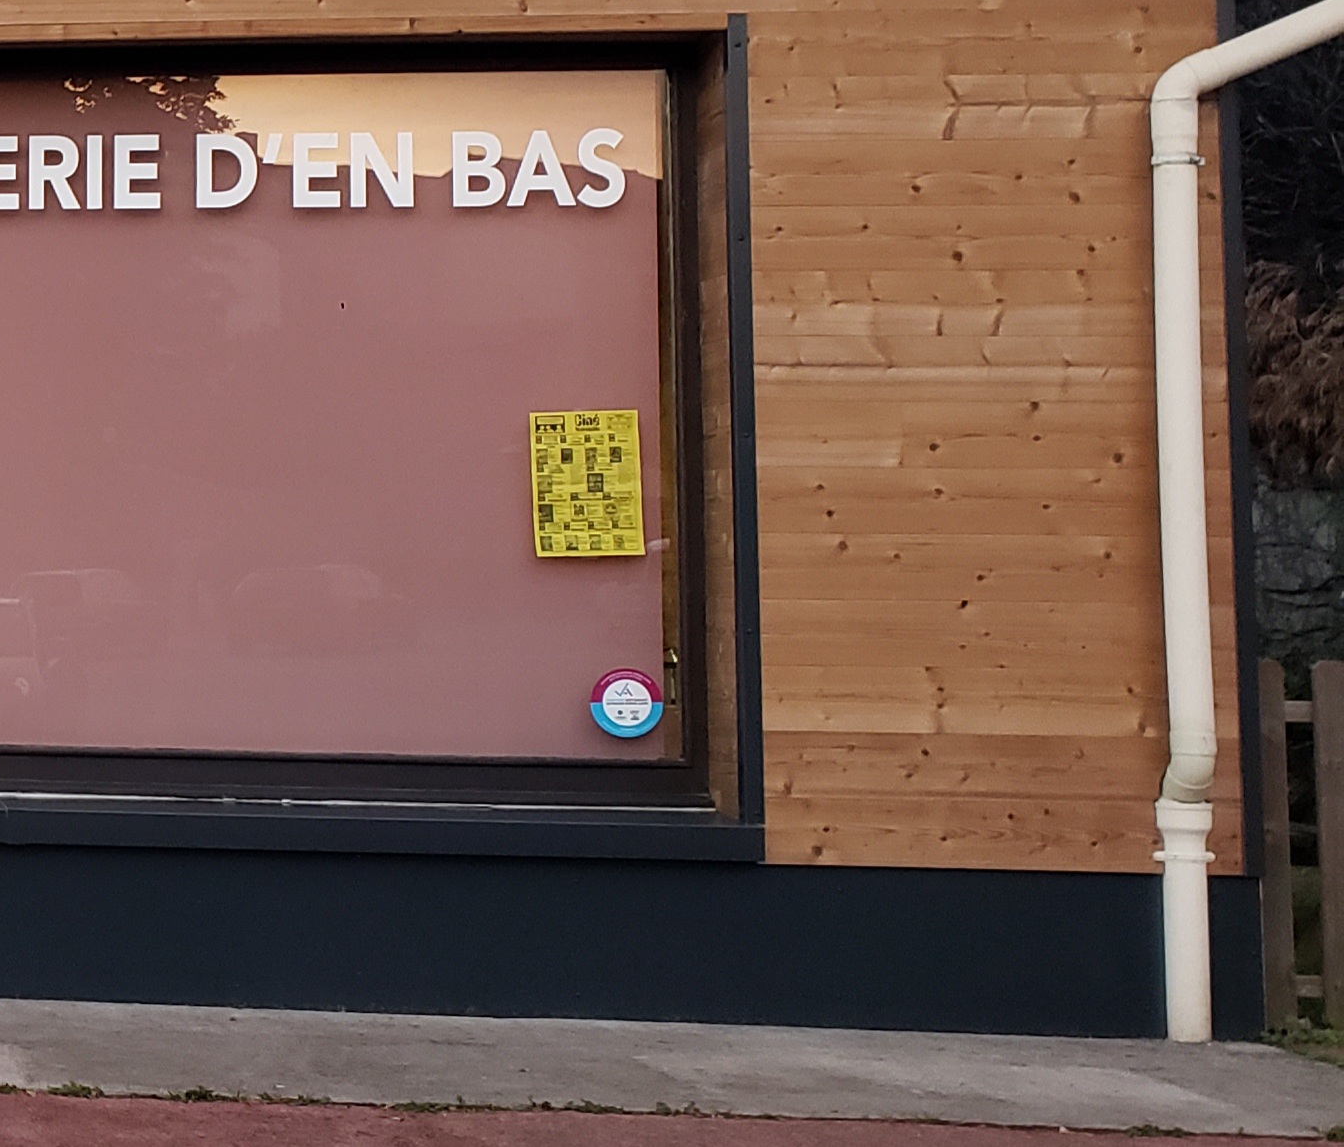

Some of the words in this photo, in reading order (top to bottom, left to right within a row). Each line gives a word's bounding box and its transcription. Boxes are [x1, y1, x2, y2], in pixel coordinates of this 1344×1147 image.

[196, 132, 414, 210] D'EN
[452, 128, 627, 209] BAS
[575, 414, 601, 427] Ciné
